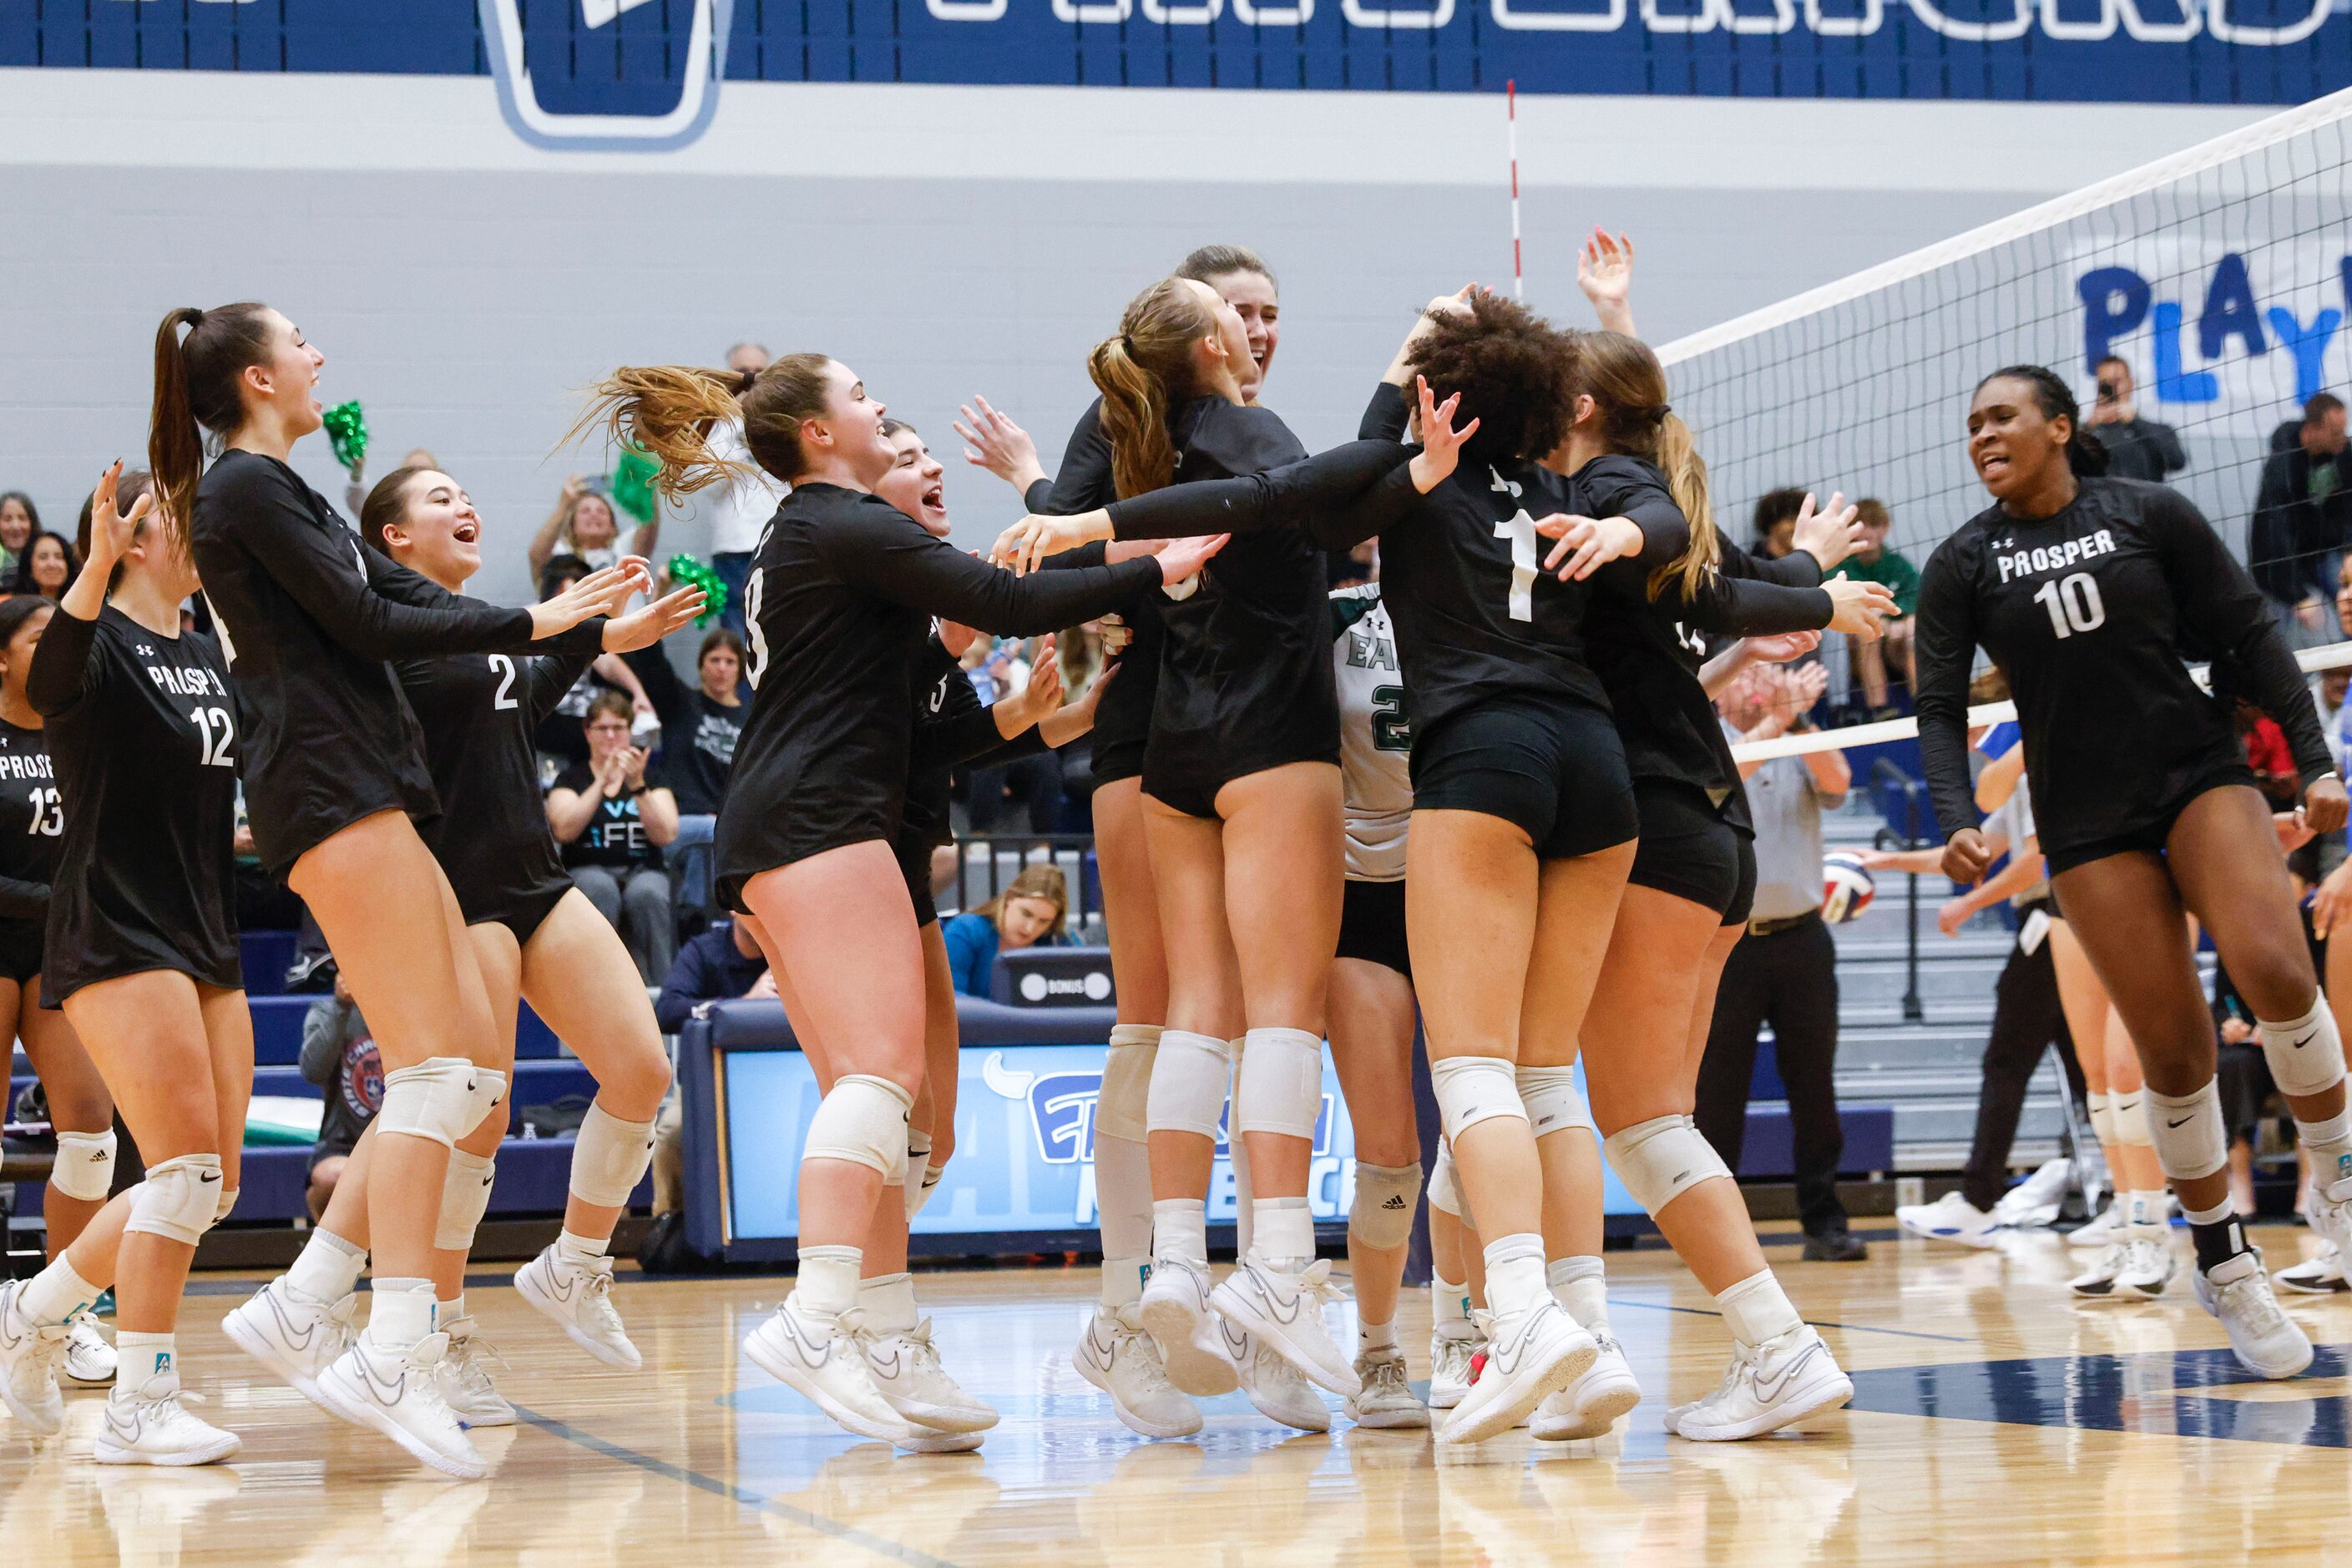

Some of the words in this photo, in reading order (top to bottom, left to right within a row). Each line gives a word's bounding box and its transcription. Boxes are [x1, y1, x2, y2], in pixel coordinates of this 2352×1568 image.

[1493, 508, 1539, 622] 1
[1996, 529, 2117, 584] PROSPER
[2033, 572, 2106, 640] 10
[1346, 632, 1401, 670] EA
[488, 654, 518, 710] 2
[190, 706, 234, 766] 12
[28, 787, 64, 836] 13
[1047, 979, 1085, 994] BONUS
